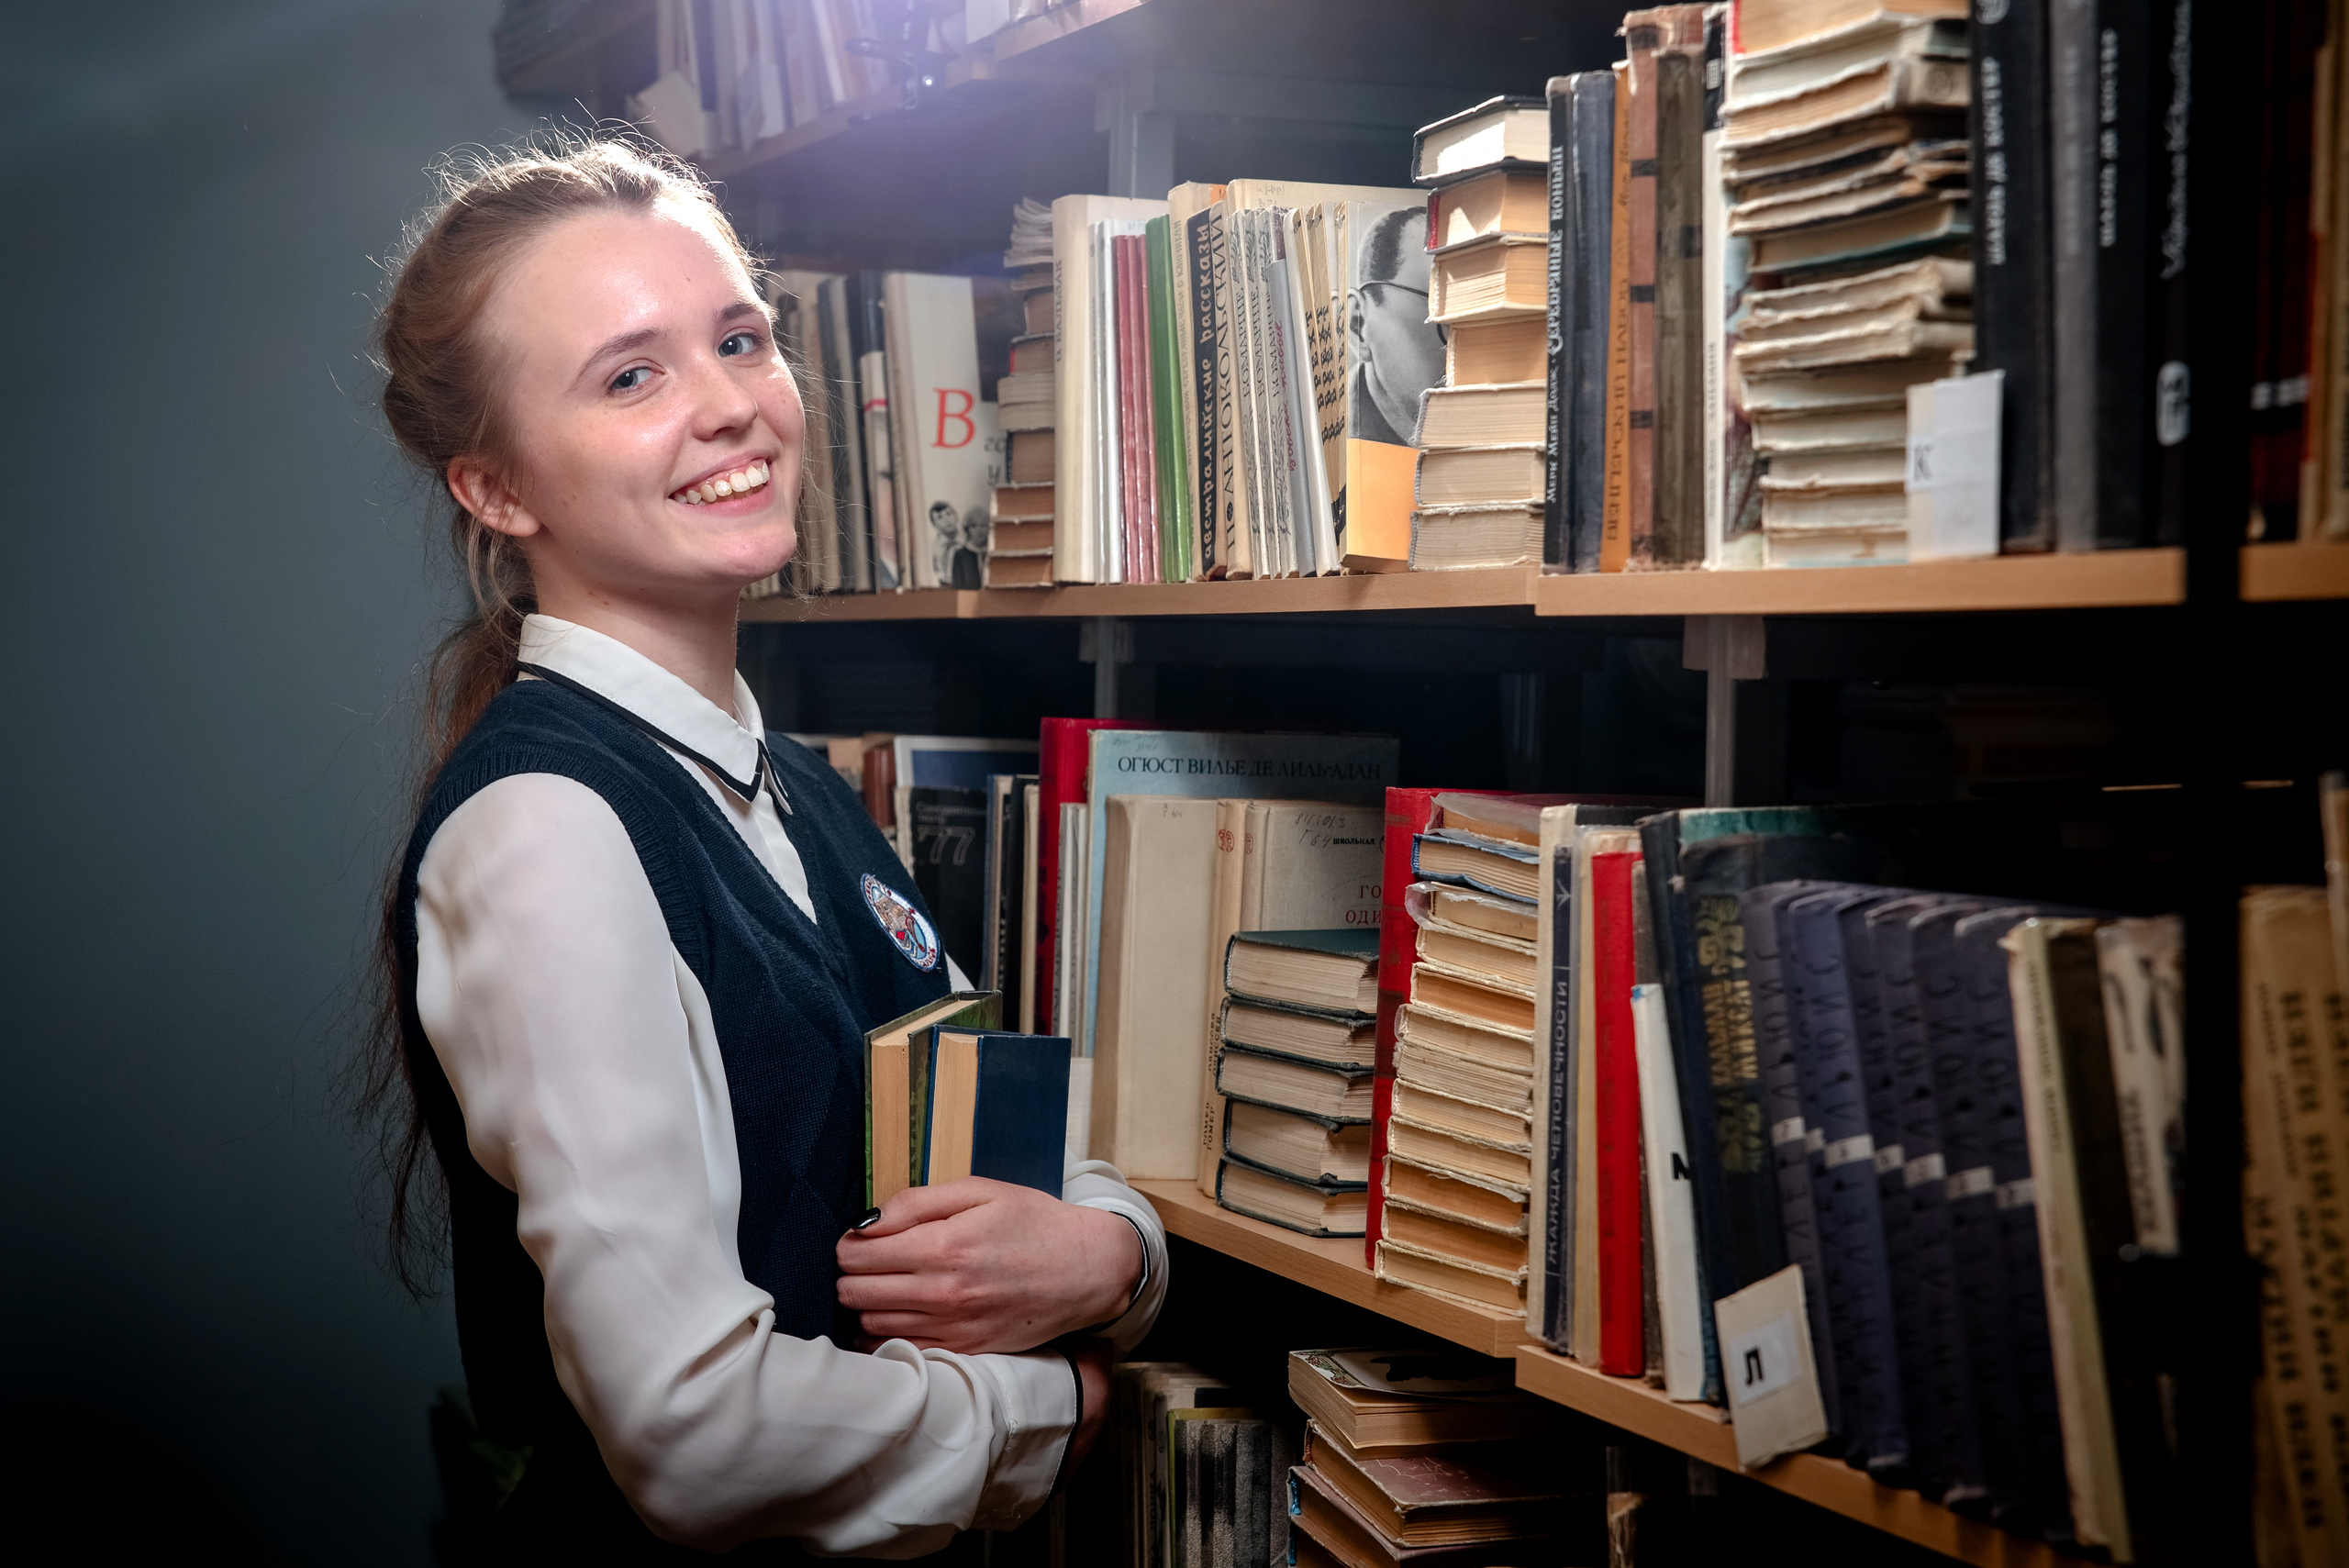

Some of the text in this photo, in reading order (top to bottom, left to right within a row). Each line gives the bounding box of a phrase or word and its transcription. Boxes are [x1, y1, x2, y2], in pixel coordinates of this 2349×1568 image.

[1549, 146, 1564, 220] КОНЬКИ
[1173, 220, 1183, 277] КЛЮЧИКОМ
[1176, 291, 1186, 319] ЧАСЫ
[1546, 229, 1564, 354] СЕРЕБРЯНЫЕ
[1178, 321, 1189, 387] СЕРЕБРЯНЫЕ
[1210, 215, 1234, 495] АНТОКОЛЬСКИЙ
[1236, 287, 1251, 398] БОМАРШЕ
[1251, 285, 1265, 397] БОМАРШЕ
[931, 388, 977, 450] В
[1197, 224, 1214, 559] австралийские рассказы
[1606, 278, 1631, 541] ВЕНГЕРСКИЙ НАБОБ
[1118, 756, 1382, 781] ОГЮСТ ВИЛЬЕ ДЕ ЛИЛЬ-АДАН
[917, 825, 976, 866] 77
[1331, 837, 1375, 847] ШКОЛЬНАЯ
[1725, 979, 1759, 1080] МИКСАТ
[1207, 1106, 1216, 1151] ГОМЕР
[1547, 981, 1568, 1264] ЖАЖДА ЧЕЛОВЕЧНОСТИ
[1745, 1348, 1764, 1386] Л
